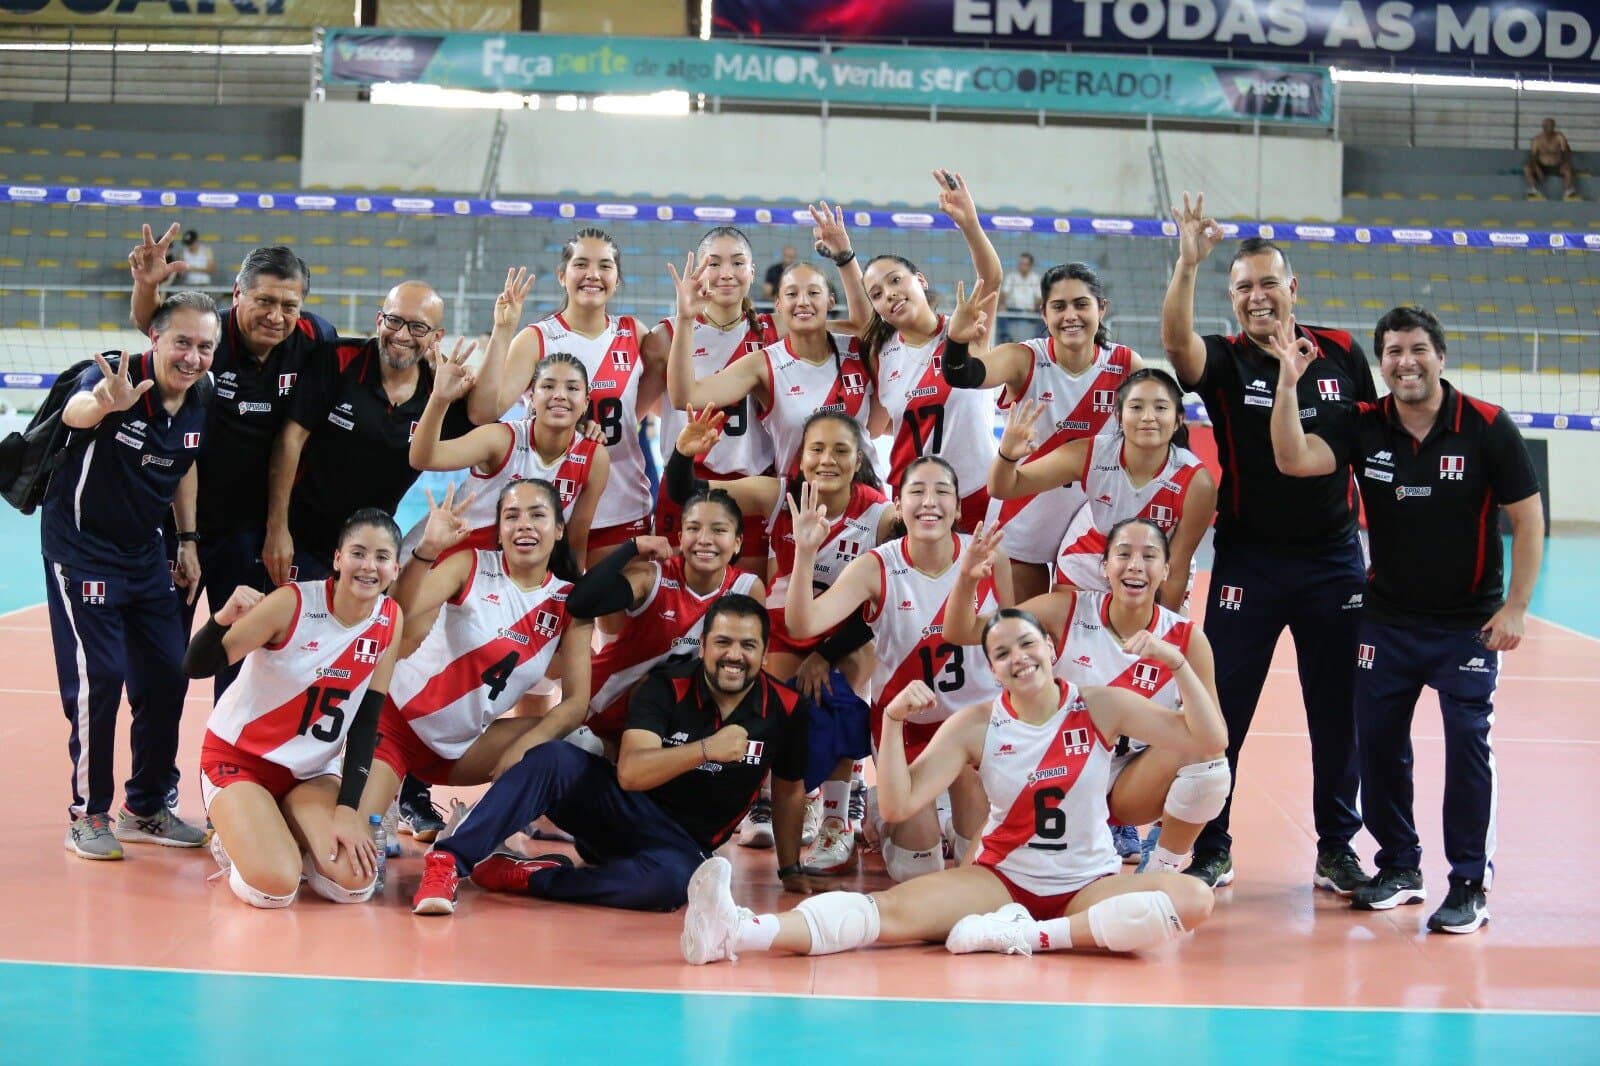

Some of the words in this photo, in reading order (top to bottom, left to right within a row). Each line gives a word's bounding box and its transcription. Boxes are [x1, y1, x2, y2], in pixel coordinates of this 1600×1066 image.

[953, 0, 1051, 36] EM
[1075, 0, 1308, 46] TODAS
[1324, 0, 1415, 51] AS
[482, 39, 552, 83] Faça
[557, 46, 627, 77] parte
[633, 57, 657, 77] de
[667, 57, 710, 82] algo
[714, 54, 826, 89] MAIOR,
[832, 61, 913, 89] venha
[920, 68, 969, 93] ser
[973, 66, 1172, 98] COOPERADO!
[614, 364, 631, 372] PER
[846, 387, 865, 396] PER
[1093, 405, 1114, 414] PER
[904, 405, 945, 457] 17
[1440, 473, 1464, 481] PER
[83, 596, 105, 605] PER
[1219, 600, 1241, 611] PER
[533, 624, 554, 639] PER
[353, 653, 377, 665] PER
[1357, 660, 1373, 670] PER
[918, 643, 966, 694] 13
[481, 651, 521, 701] 4
[1132, 678, 1156, 691] PER
[296, 686, 351, 743] 15
[1065, 746, 1090, 757] PER
[1034, 786, 1067, 839] 6
